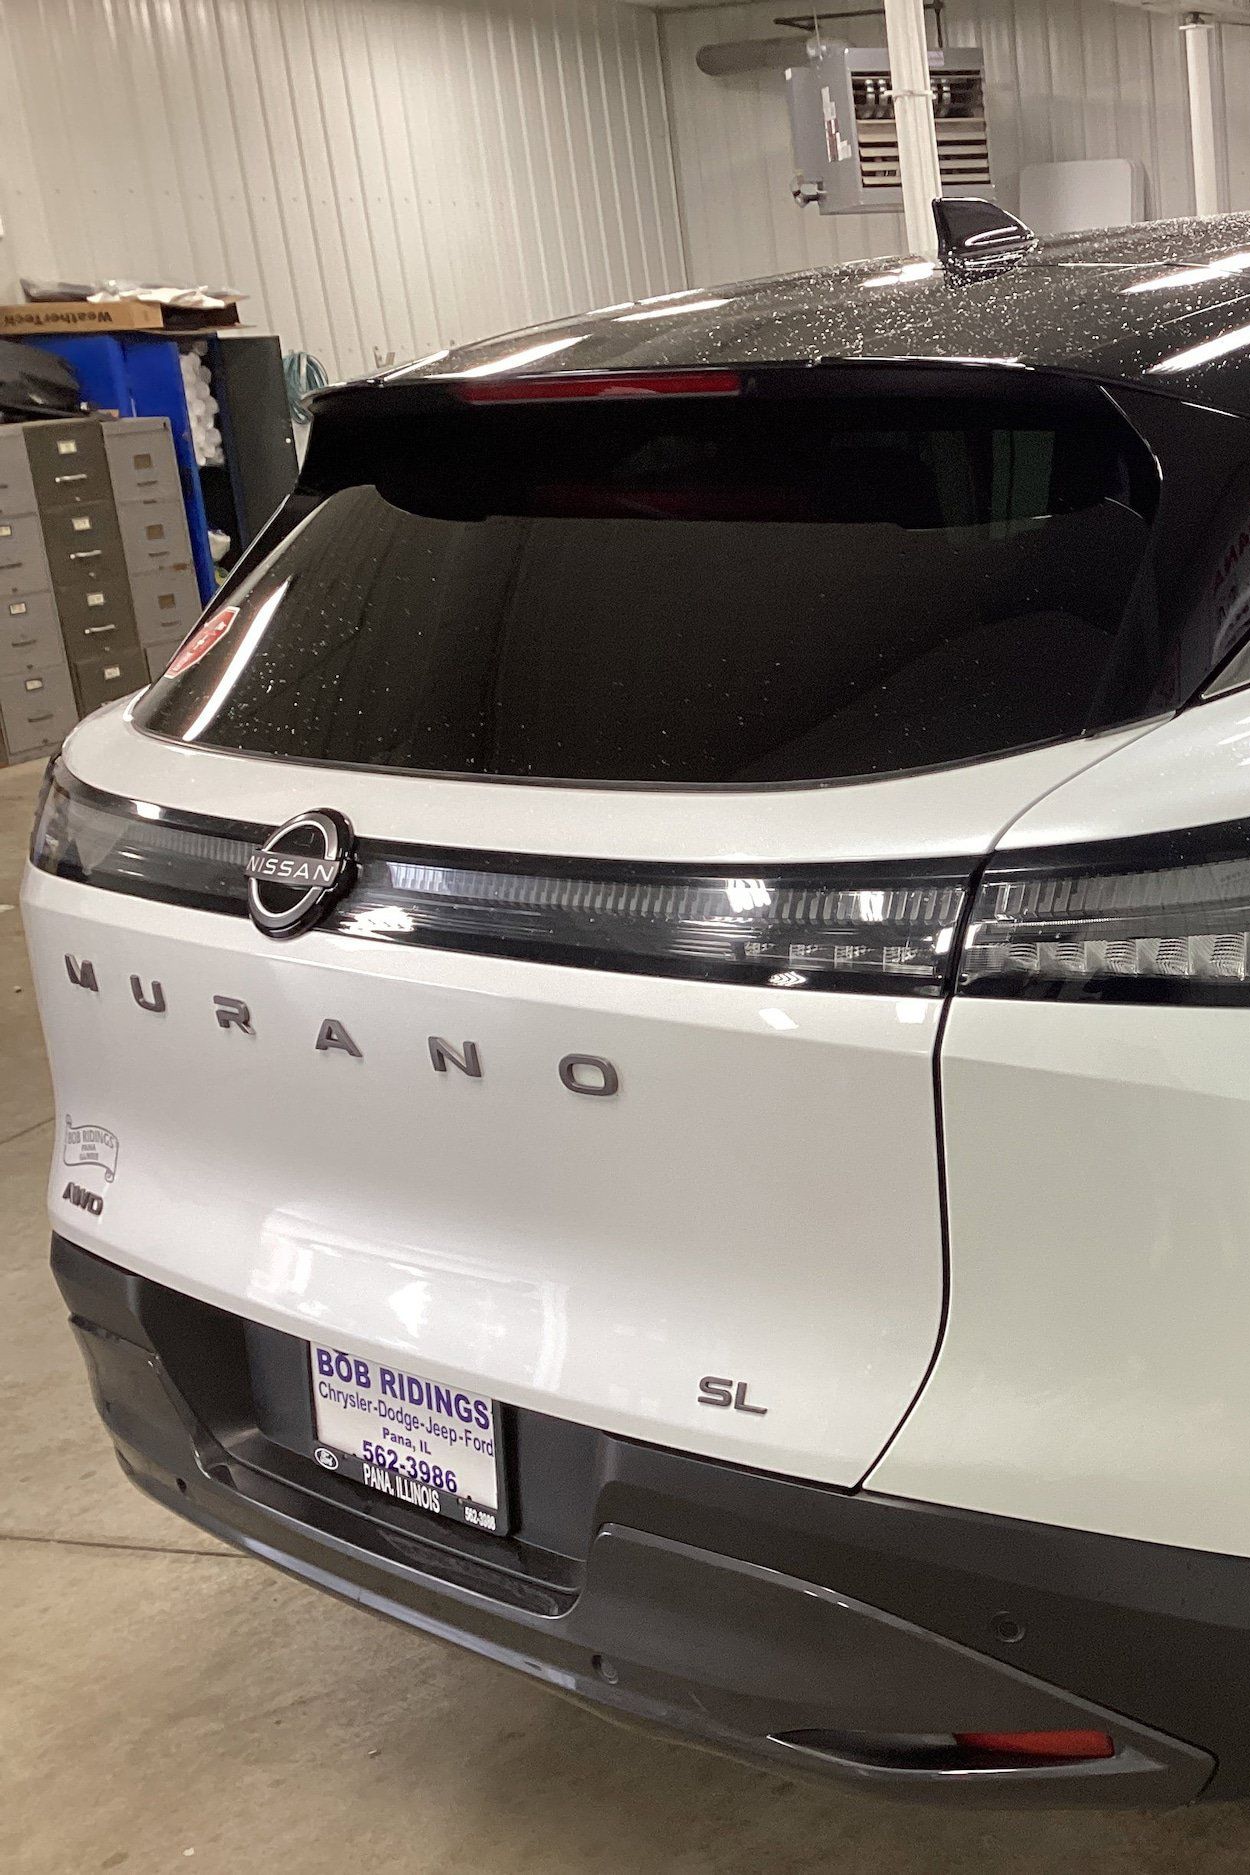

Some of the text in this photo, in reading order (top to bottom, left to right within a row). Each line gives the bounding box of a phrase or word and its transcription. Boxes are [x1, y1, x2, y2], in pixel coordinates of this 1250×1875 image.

[246, 855, 334, 882] NISSAN
[64, 953, 619, 1096] MURANO
[63, 1182, 103, 1216] AWD
[316, 1348, 491, 1430] BOB RIDINGS
[697, 1376, 768, 1414] SL
[318, 1381, 495, 1457] Chrysler-Dodge-Jeep-Ford
[382, 1427, 432, 1455] Pana, IL
[362, 1440, 458, 1493] 562-3986
[395, 1475, 441, 1513] ILLINOIS
